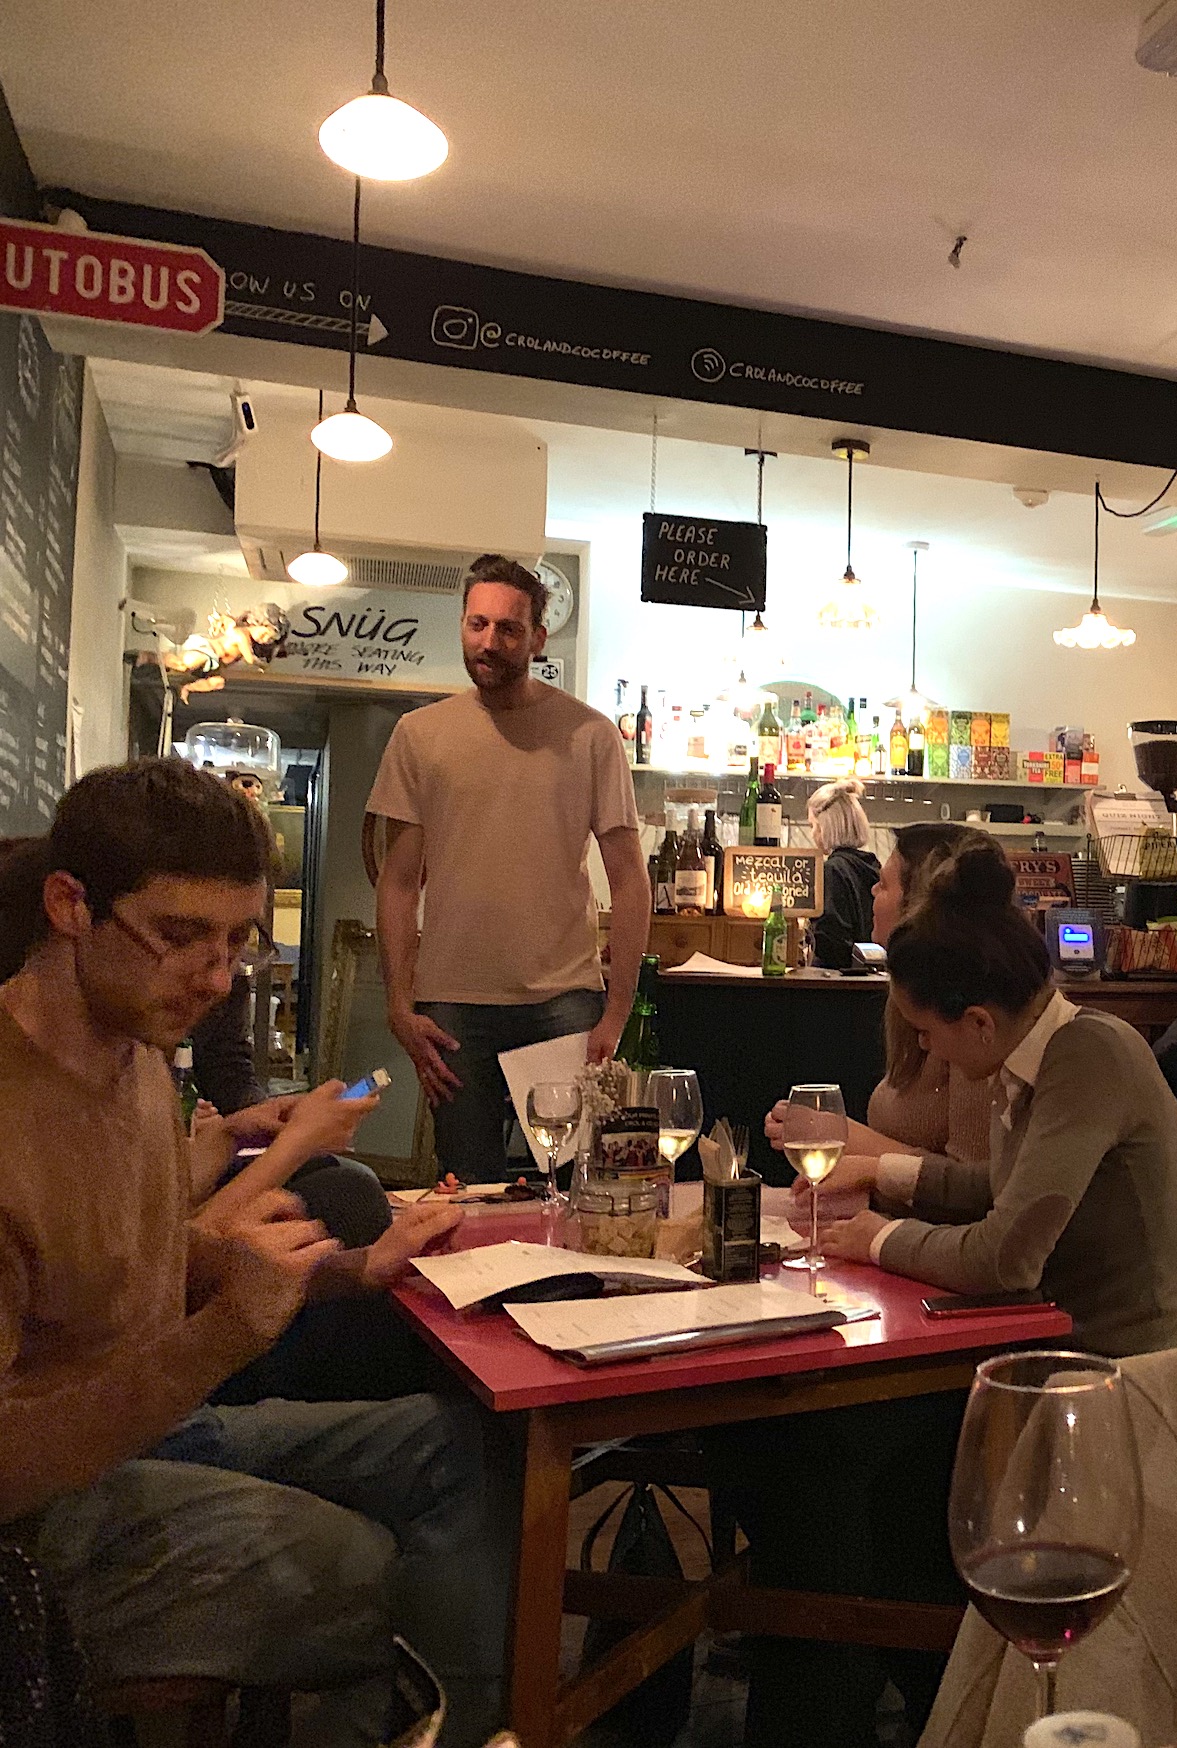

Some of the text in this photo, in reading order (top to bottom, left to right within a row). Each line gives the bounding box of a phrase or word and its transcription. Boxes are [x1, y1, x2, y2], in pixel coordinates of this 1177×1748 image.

[6, 241, 202, 314] UTOBUS
[283, 280, 316, 301] US
[339, 290, 371, 311] ON
[658, 521, 719, 545] PLEASE
[674, 549, 731, 570] ORDER
[655, 564, 701, 585] HERE
[291, 605, 420, 647] SNÜG
[352, 644, 425, 666] SEATING
[303, 657, 397, 677] THIS WAY
[1044, 770, 1063, 778] FREE
[735, 855, 809, 869] Mezcal or
[1010, 860, 1057, 873] FRY'S
[750, 867, 803, 884] tequila
[755, 883, 809, 898] fasoned
